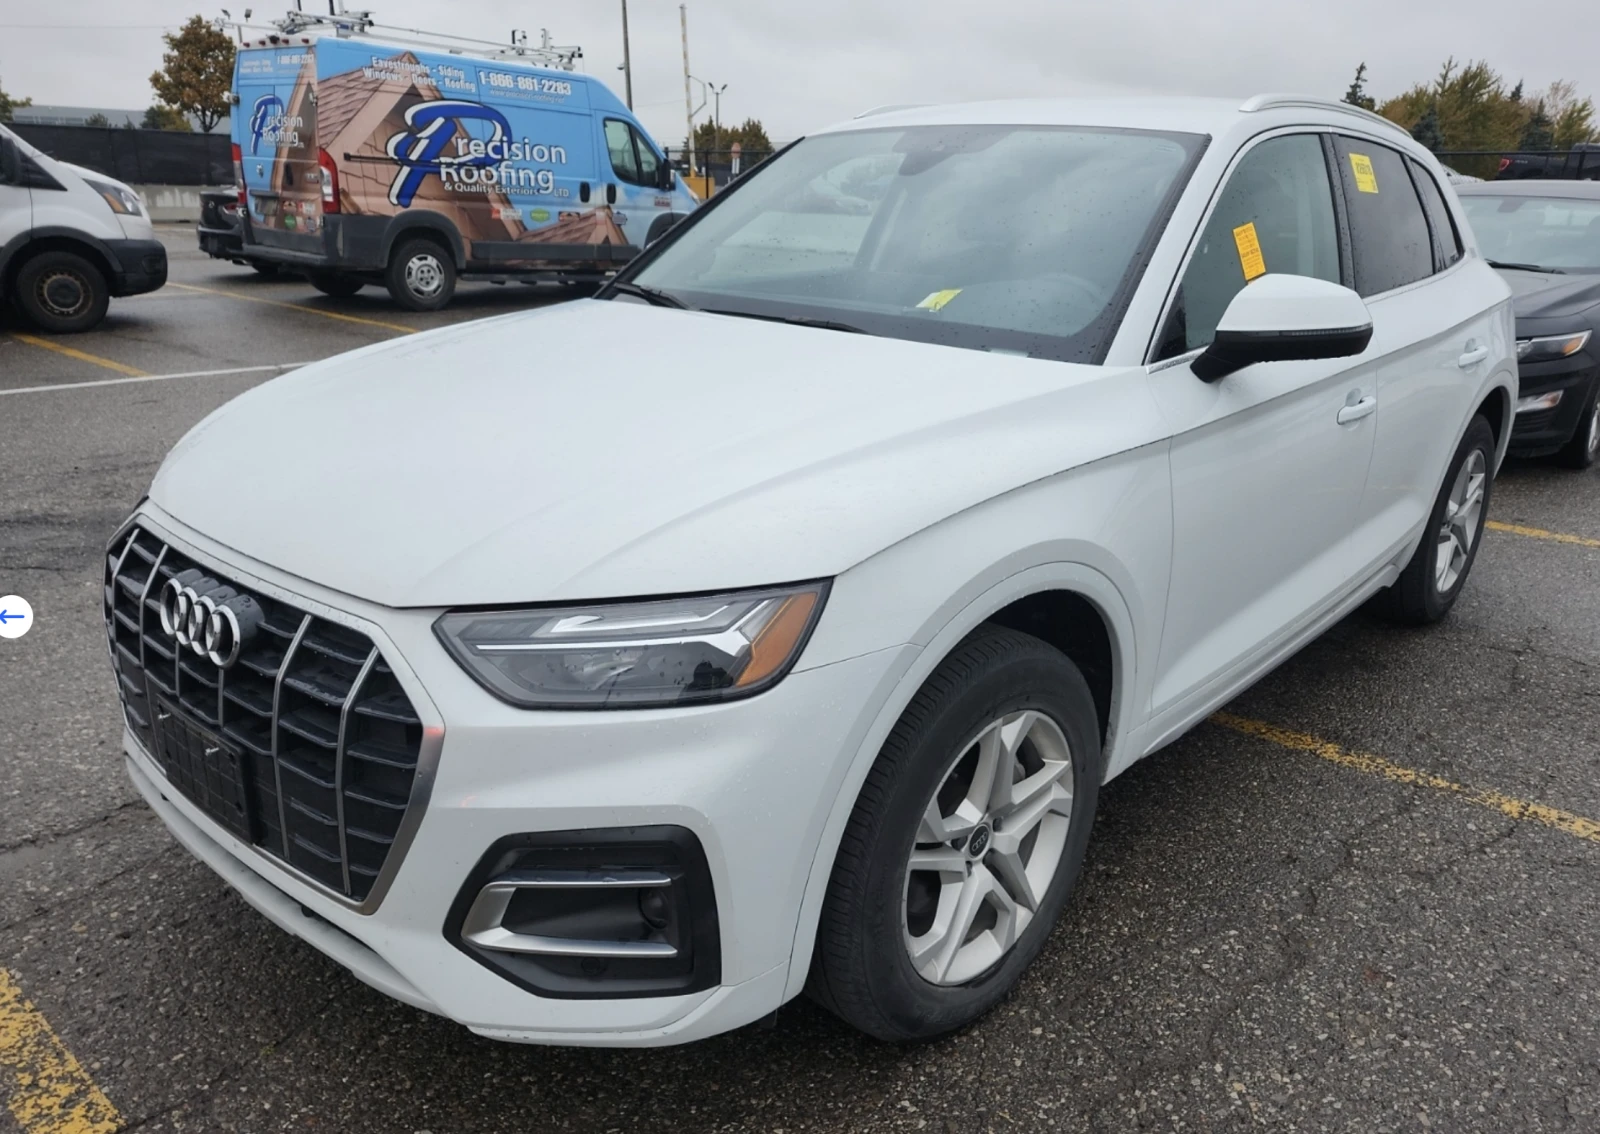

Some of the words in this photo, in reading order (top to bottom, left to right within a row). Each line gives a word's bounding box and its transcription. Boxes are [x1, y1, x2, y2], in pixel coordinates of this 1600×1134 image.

[372, 56, 431, 74] Eavestroughs
[438, 65, 465, 79] Siding
[362, 67, 404, 81] Windows
[411, 73, 437, 86] Doors
[444, 77, 476, 93] Roofing
[440, 156, 554, 194] Roofing
[454, 183, 493, 194] Quality
